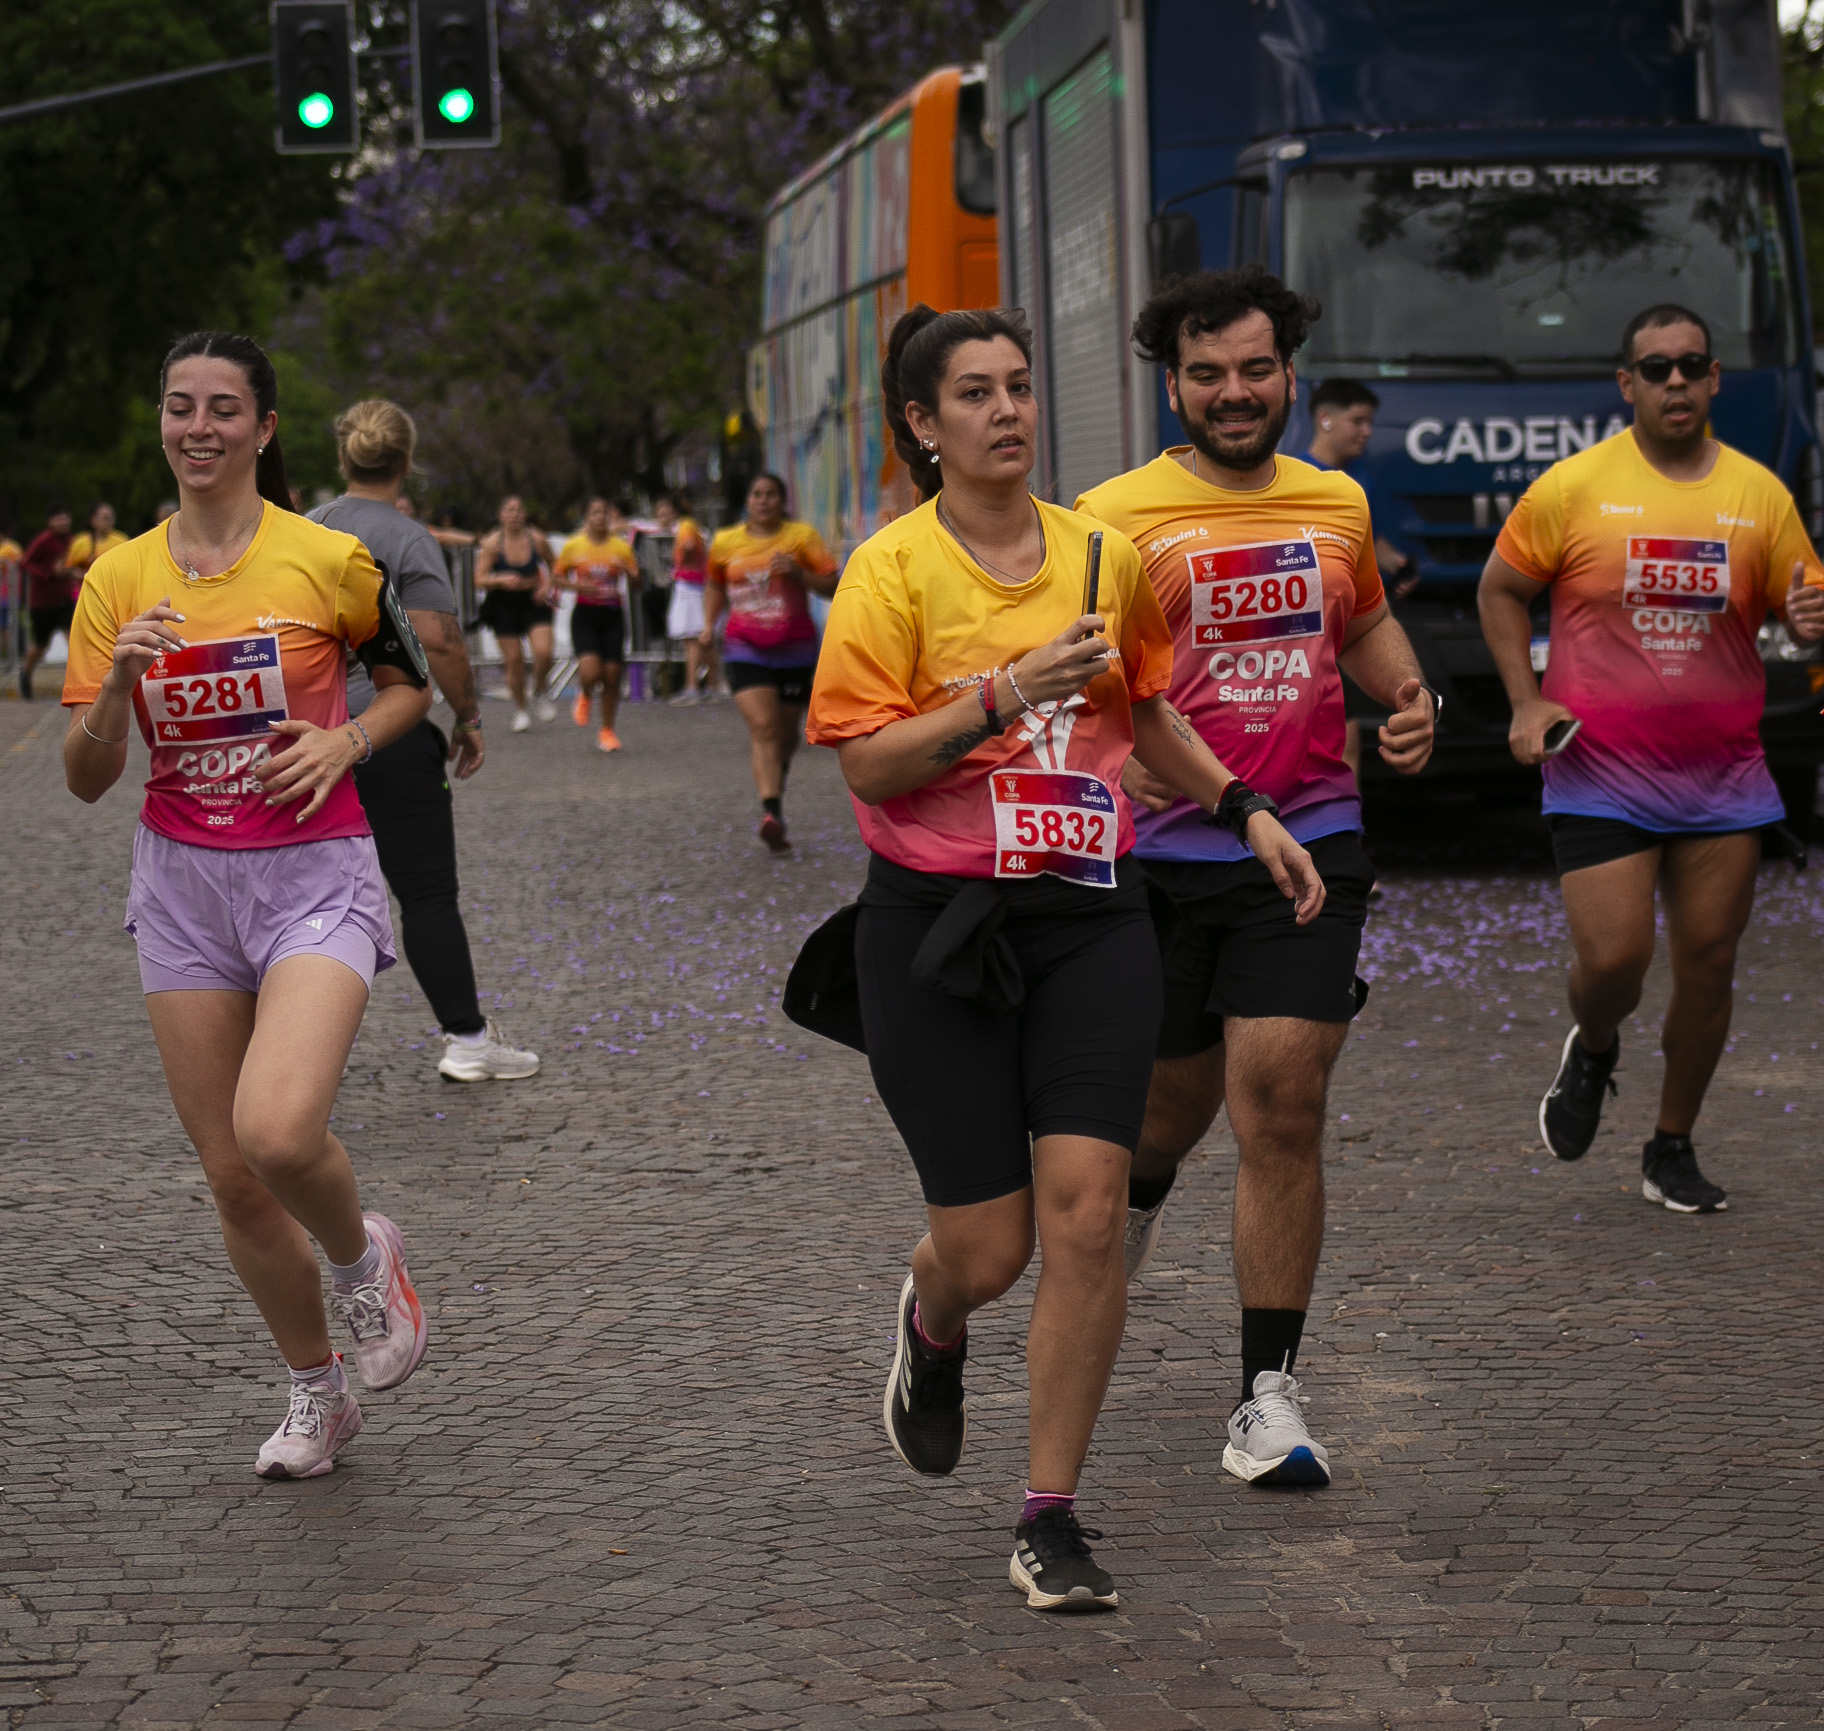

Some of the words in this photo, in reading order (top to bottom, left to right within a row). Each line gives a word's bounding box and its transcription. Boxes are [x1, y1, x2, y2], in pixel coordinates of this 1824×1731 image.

[1413, 167, 1535, 189] PUNTO
[1546, 163, 1659, 186] TRUCK
[1199, 527, 1208, 536] 6
[1276, 558, 1299, 567] Santa
[1299, 556, 1309, 564] Fe
[1639, 564, 1718, 594] 5535
[1210, 575, 1308, 620] 5280
[1631, 593, 1647, 605] 4k
[1632, 610, 1711, 635] COPA
[1203, 626, 1223, 640] 4k
[1641, 636, 1685, 652] Santa
[1686, 639, 1702, 652] Fe
[233, 655, 259, 664] Santa
[259, 653, 270, 661] Fe
[1208, 649, 1312, 680] COPA
[164, 673, 265, 718] 5281
[1218, 685, 1275, 702] Santa
[1277, 684, 1299, 702] Fe
[1238, 706, 1277, 714] PROVINCIA
[164, 724, 182, 738] 4k
[1244, 723, 1270, 733] 2025
[177, 743, 272, 778] COPA
[183, 780, 239, 794] Santa
[242, 777, 264, 794] Fe
[202, 798, 243, 806] PROVINCIA
[1081, 793, 1100, 804] Santa
[1100, 796, 1109, 805] Fe
[207, 815, 235, 825] 2025
[1015, 808, 1105, 855] 5832
[1006, 854, 1028, 871] 4k
